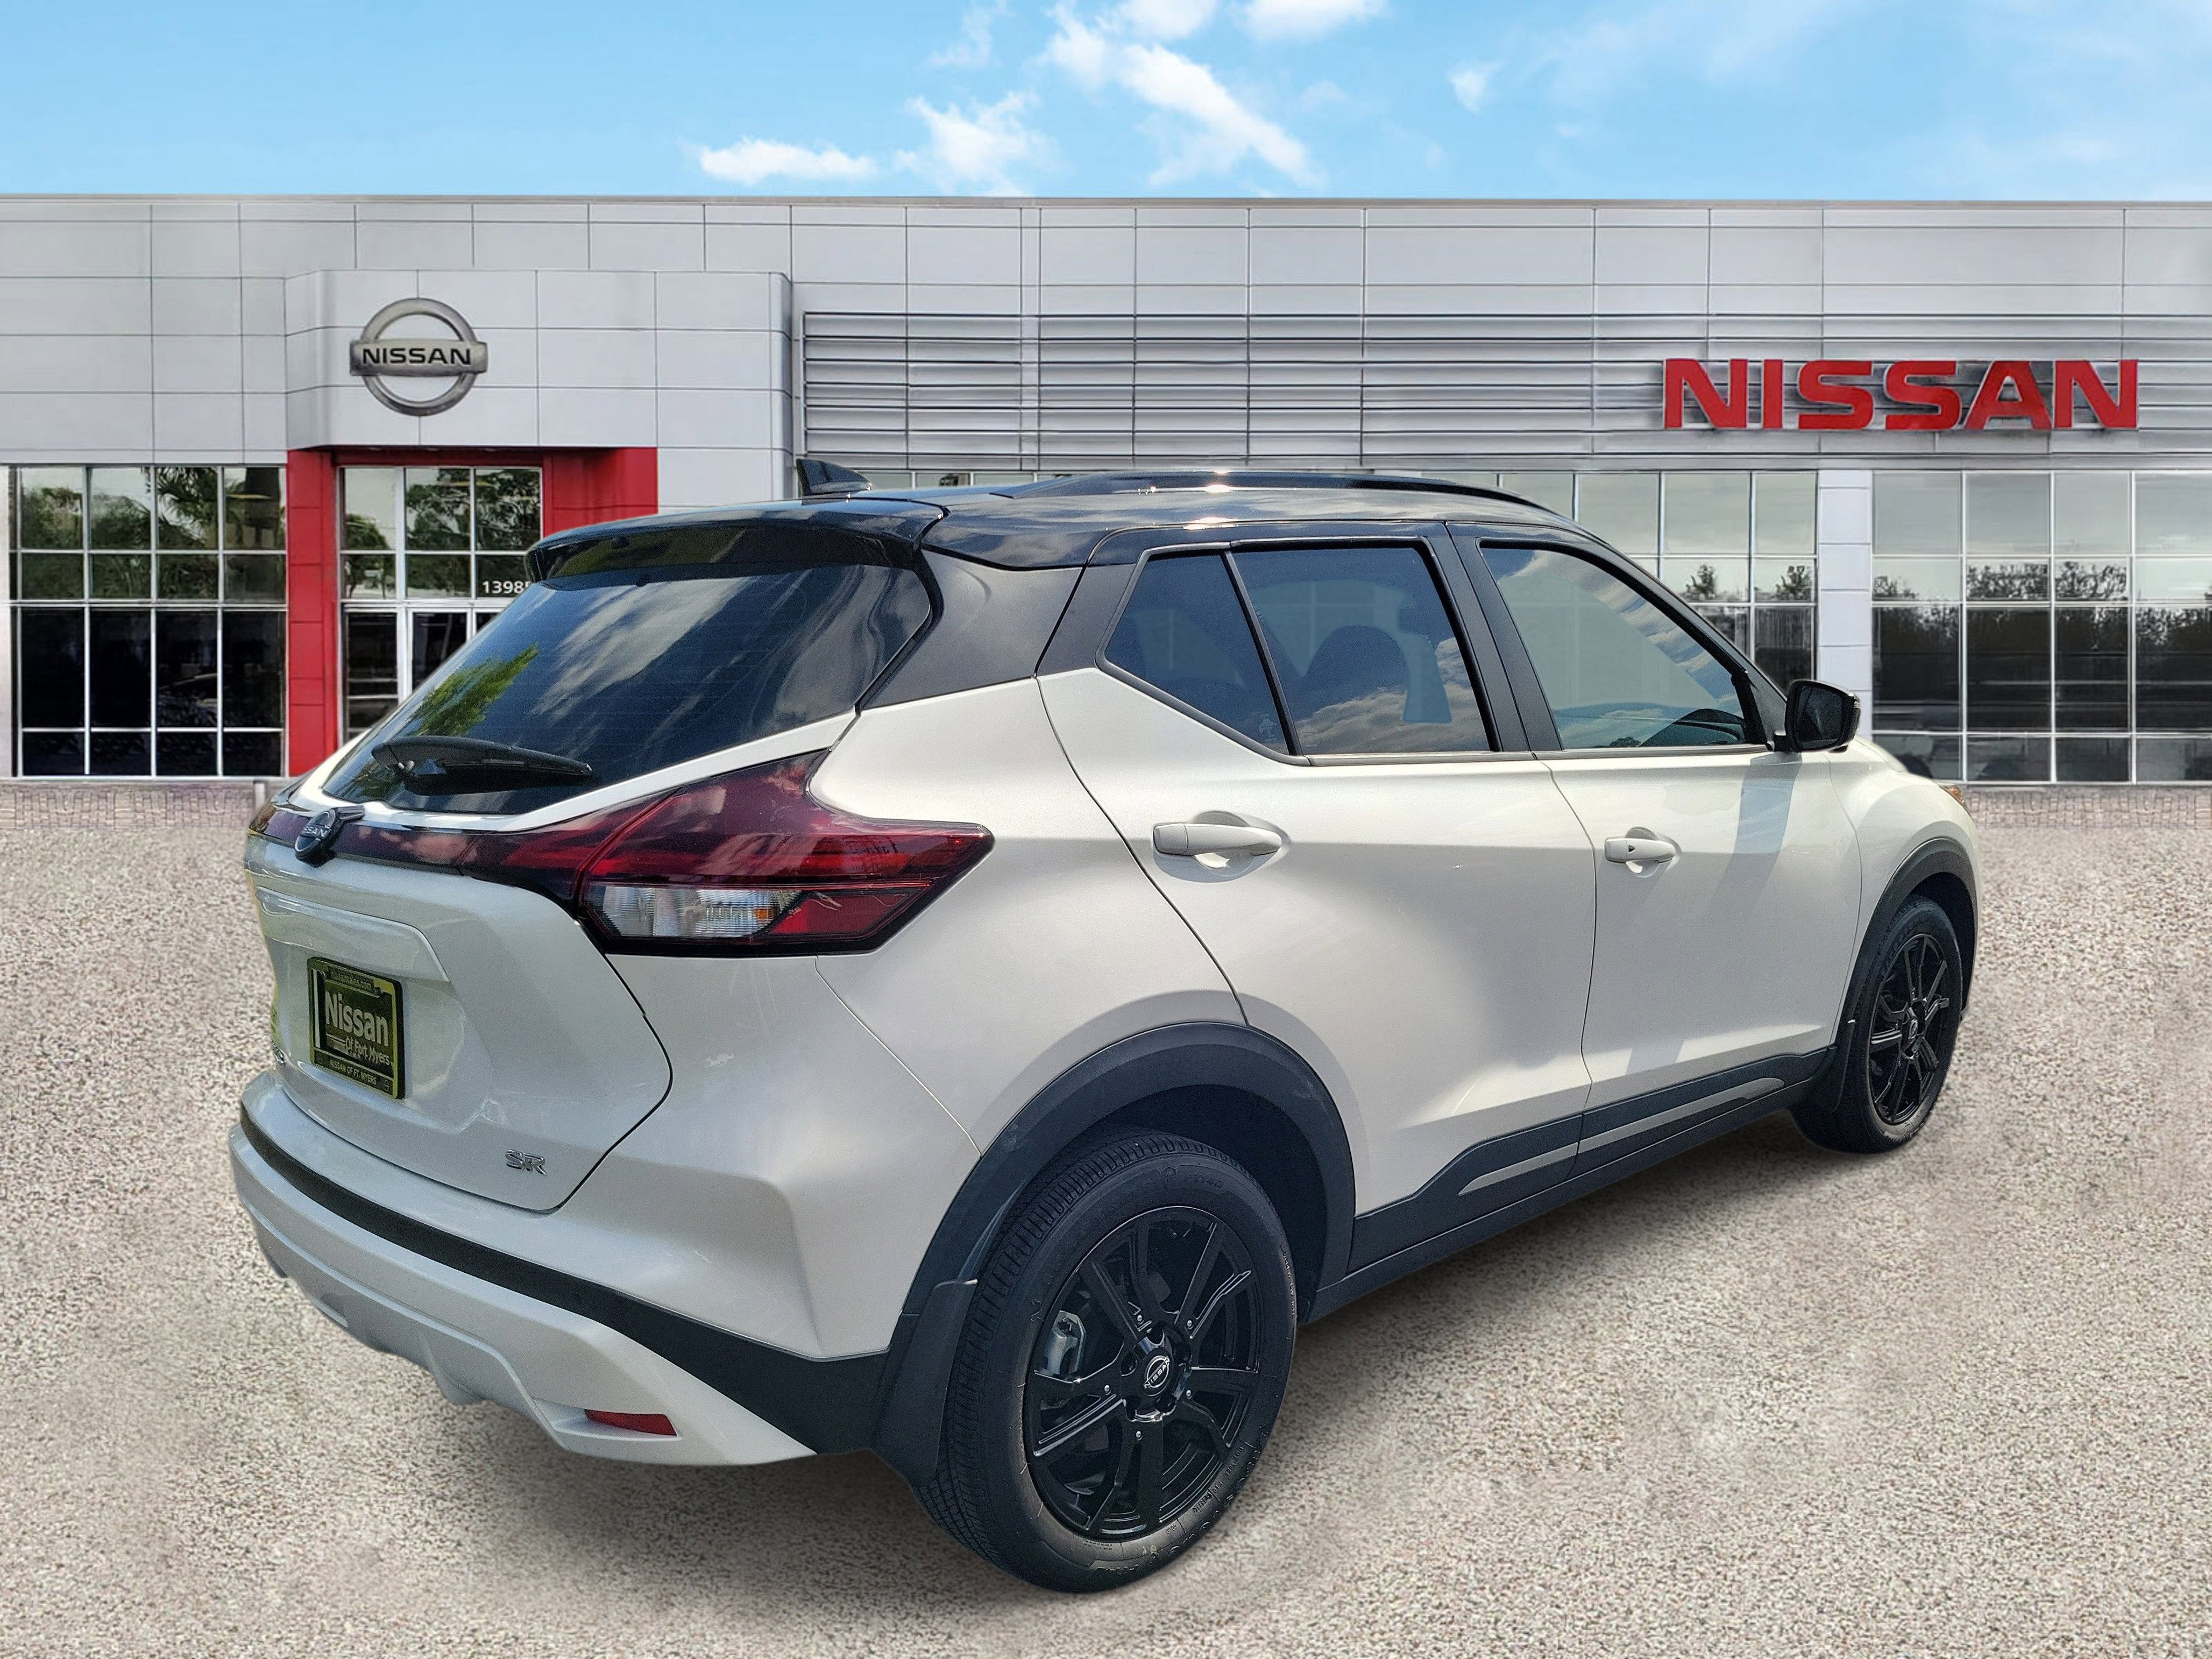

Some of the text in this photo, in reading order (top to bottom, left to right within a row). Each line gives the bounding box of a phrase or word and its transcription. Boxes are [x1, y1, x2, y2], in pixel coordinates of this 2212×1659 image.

[363, 348, 471, 365] NISSAN
[1663, 358, 2139, 430] NISSAN
[325, 990, 389, 1047] Nissan
[505, 1149, 548, 1176] SR
[1144, 1356, 1170, 1389] NISSAN
